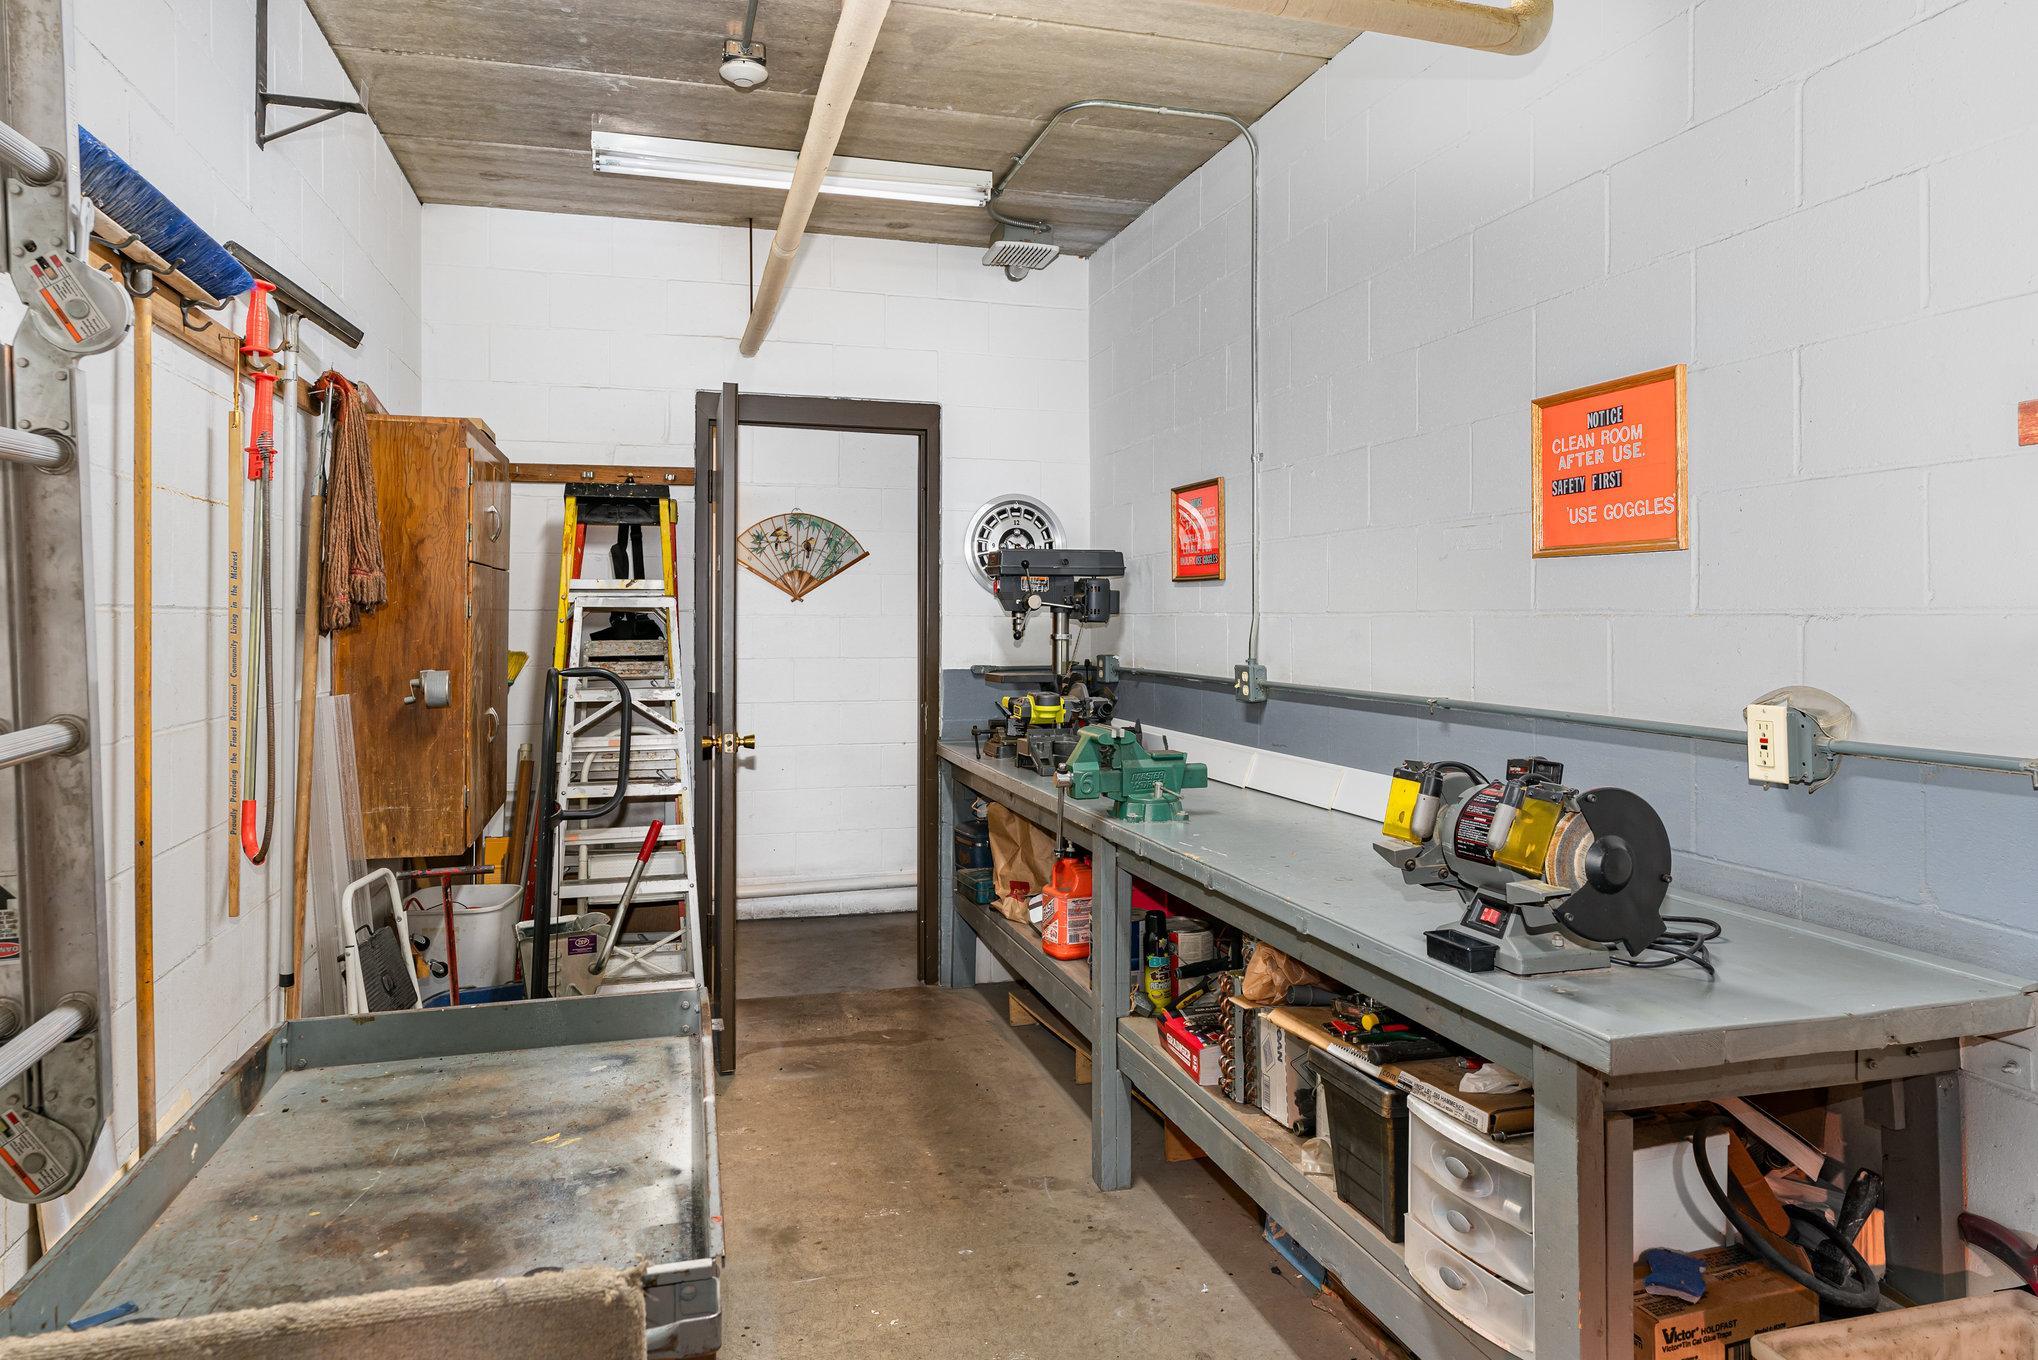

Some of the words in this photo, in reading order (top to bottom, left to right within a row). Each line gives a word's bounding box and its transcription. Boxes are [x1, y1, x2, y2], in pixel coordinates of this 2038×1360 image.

[1587, 405, 1623, 429] NOTICE
[1552, 432, 1594, 454] CLEAN
[1601, 424, 1643, 446] ROOM
[1558, 449, 1605, 471] AFTER
[1612, 442, 1645, 463] USE.
[1552, 476, 1585, 496] SAFETY
[1592, 470, 1622, 491] FIRST
[230, 551, 238, 580] Midwest
[230, 584, 238, 596] the
[230, 601, 238, 609] in
[230, 613, 238, 635] Living
[230, 640, 238, 678] Community
[230, 684, 238, 722] Retirement
[230, 727, 238, 748] Finest
[230, 769, 238, 803] Providing
[1078, 771, 1095, 795] 6
[230, 808, 238, 835] Proudly
[1700, 1319, 1738, 1336] HOLDFAST
